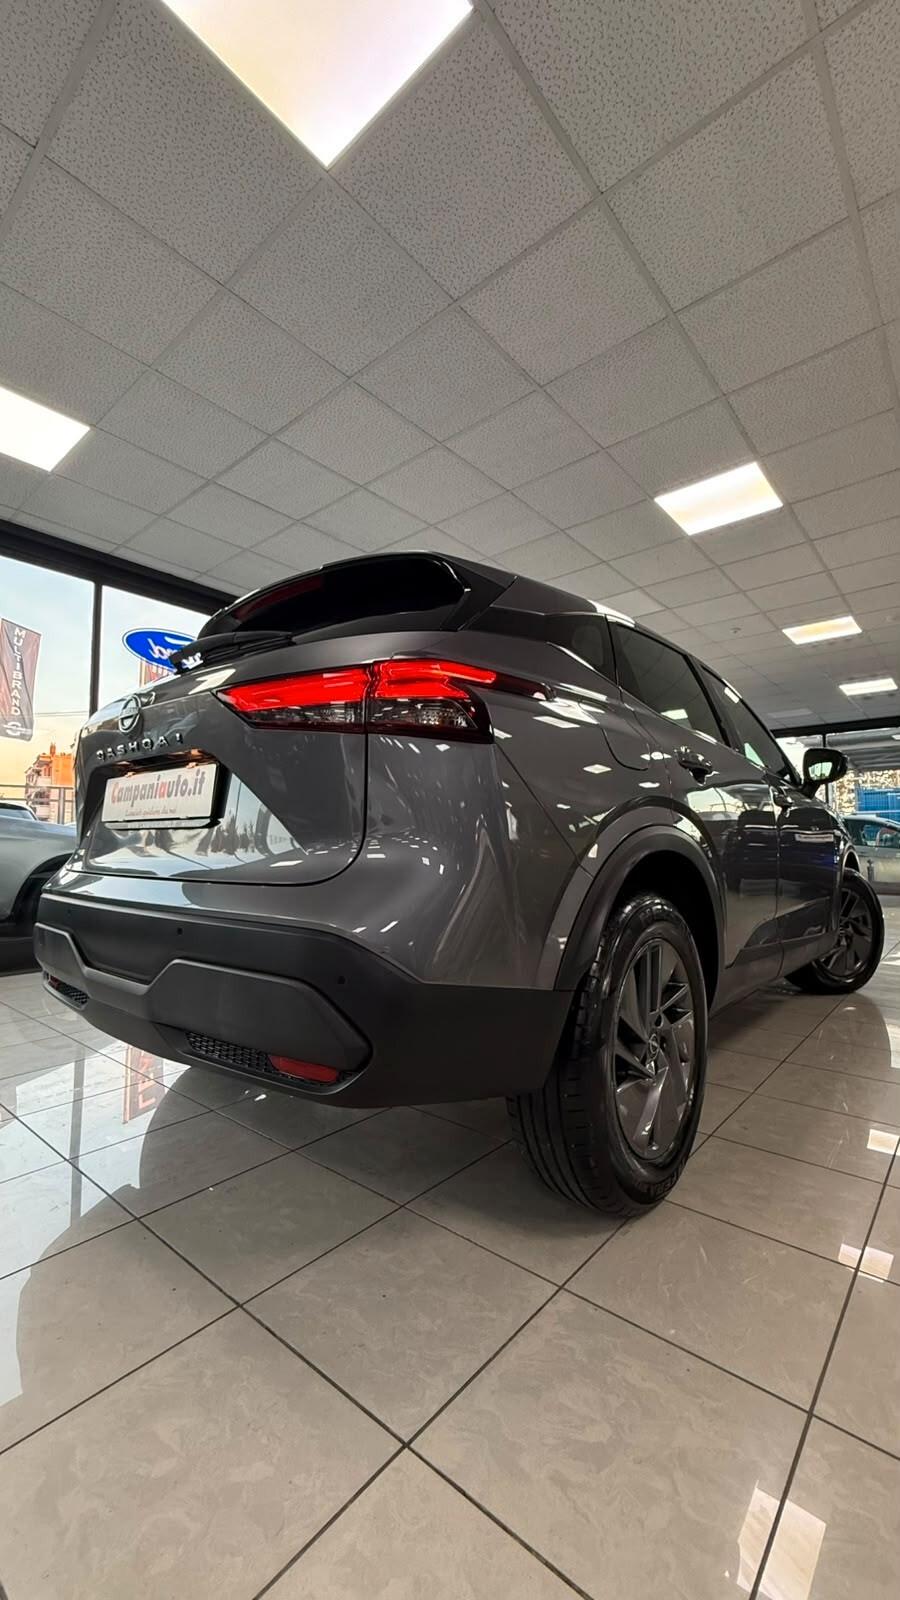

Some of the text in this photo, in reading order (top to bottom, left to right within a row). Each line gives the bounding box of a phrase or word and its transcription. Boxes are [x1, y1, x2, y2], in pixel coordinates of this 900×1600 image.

[11, 628, 26, 716] MULTIBRAND
[96, 733, 183, 761] QASHQAI
[111, 768, 206, 807] Campaniauto.it
